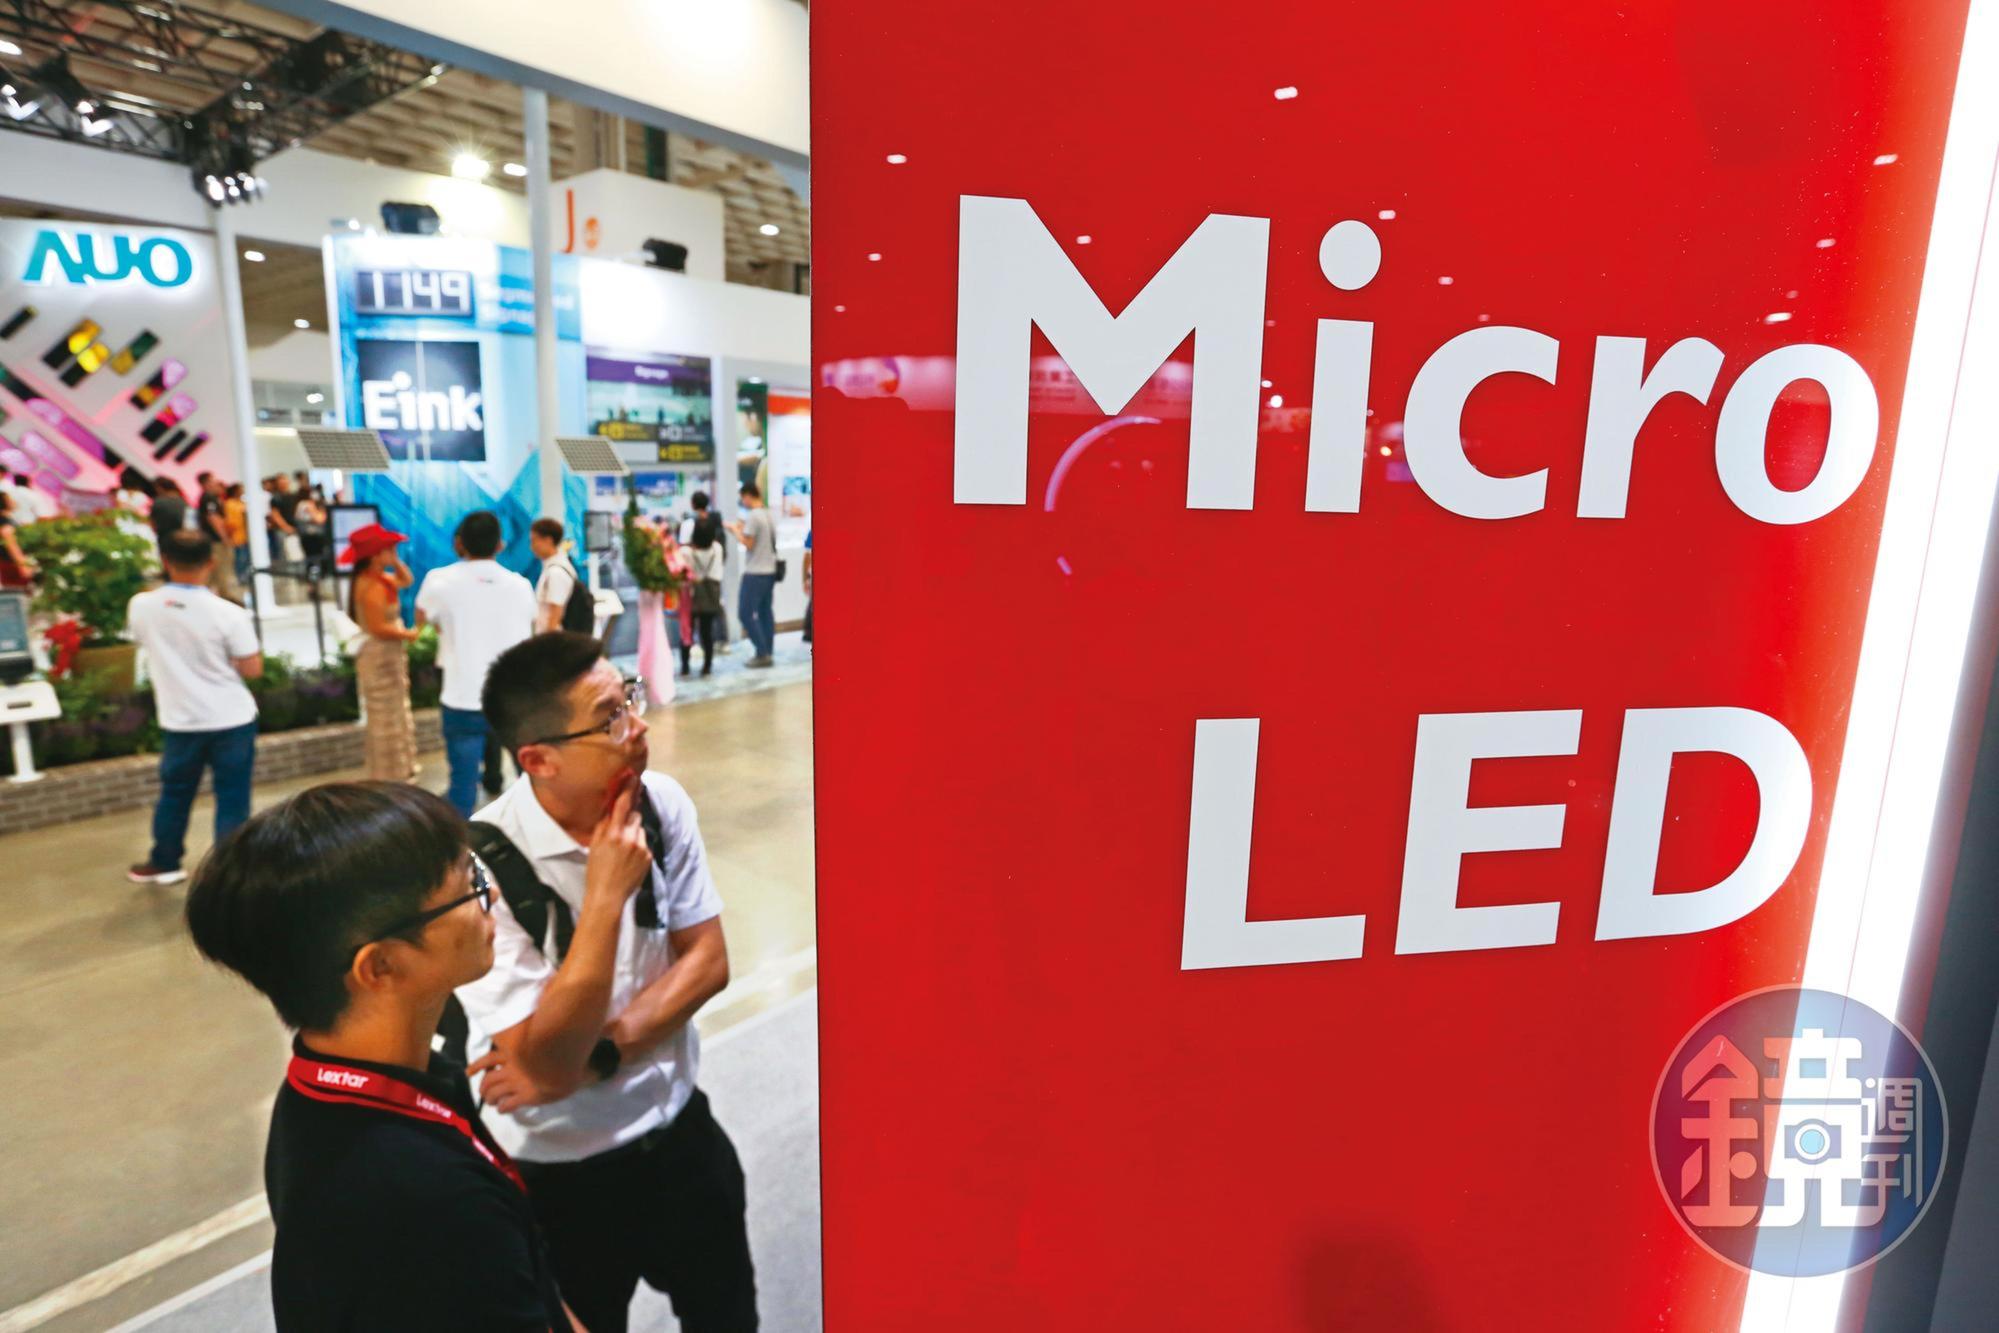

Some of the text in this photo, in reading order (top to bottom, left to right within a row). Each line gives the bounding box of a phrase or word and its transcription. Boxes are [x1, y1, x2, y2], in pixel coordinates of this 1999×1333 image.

[22, 230, 193, 288] AUO
[954, 195, 1880, 524] Micro
[1181, 707, 1813, 970] LED
[317, 1067, 369, 1089] Lextar
